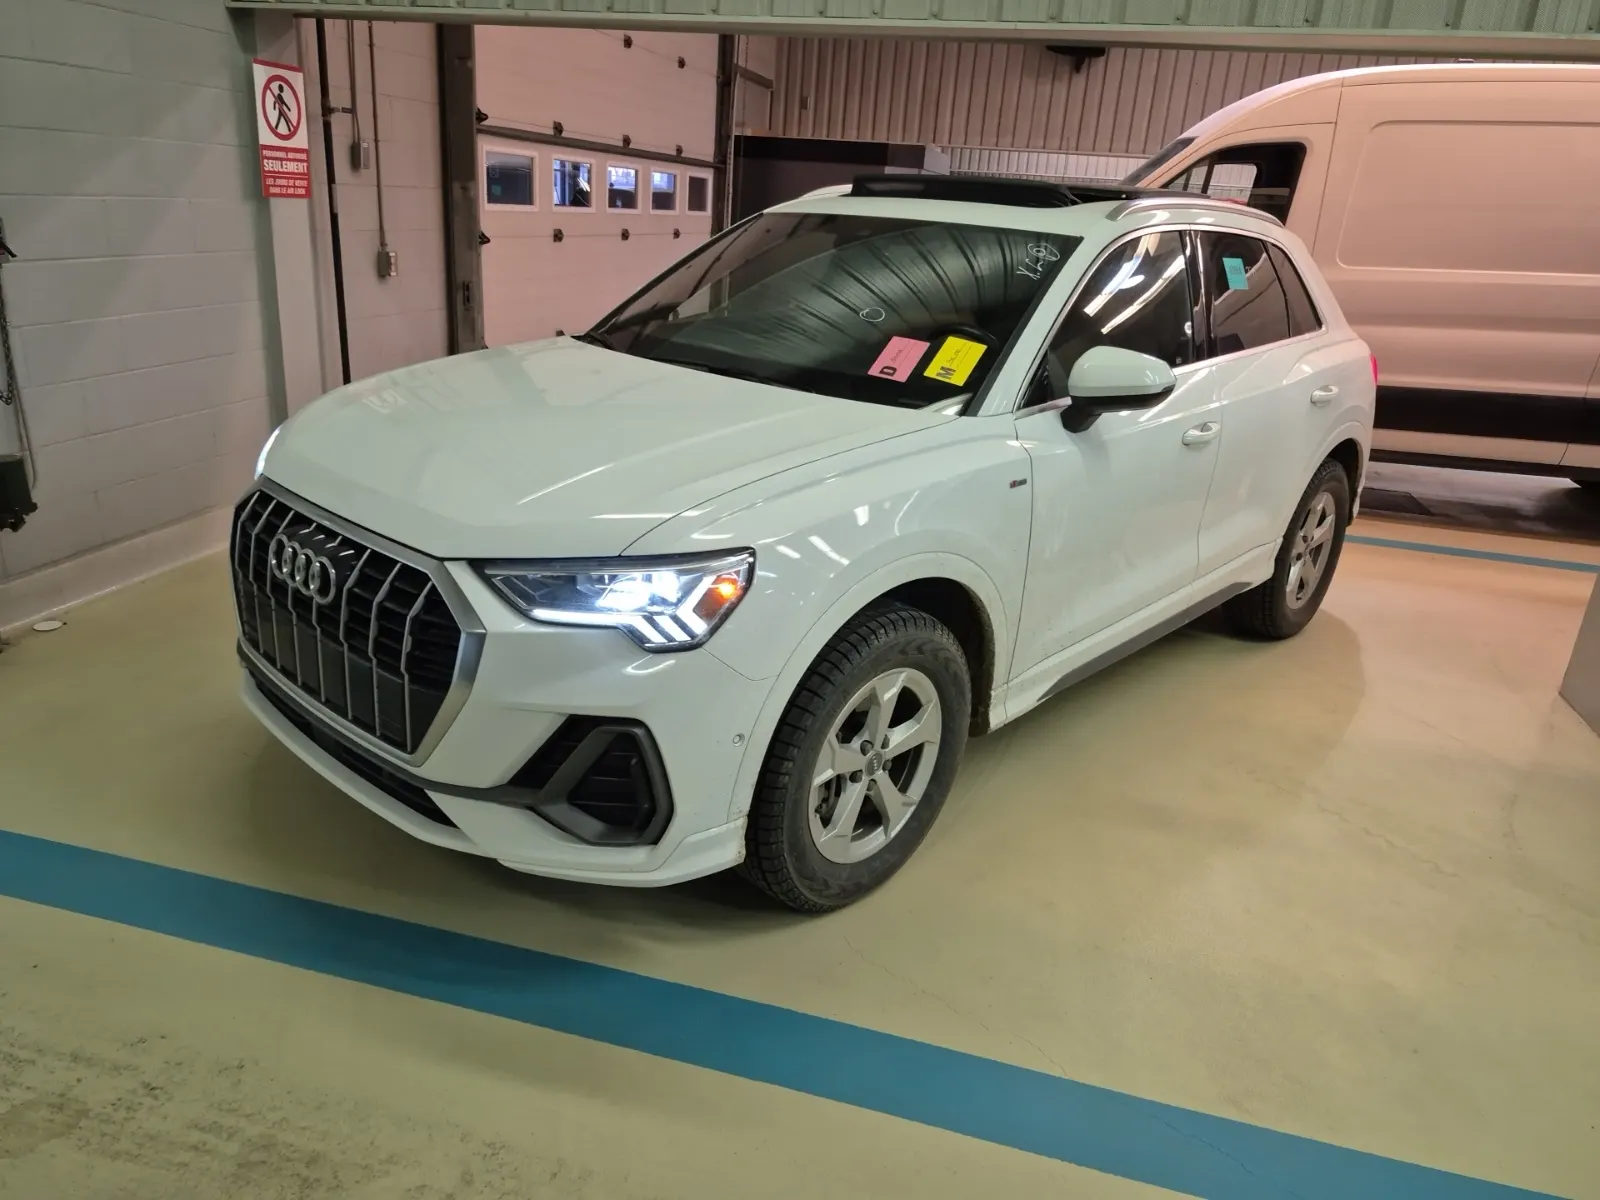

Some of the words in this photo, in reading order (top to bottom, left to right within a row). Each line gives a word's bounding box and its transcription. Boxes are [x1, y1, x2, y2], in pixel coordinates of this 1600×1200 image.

[263, 159, 308, 173] SEULEMENT
[879, 366, 897, 377] D
[936, 366, 956, 380] M
